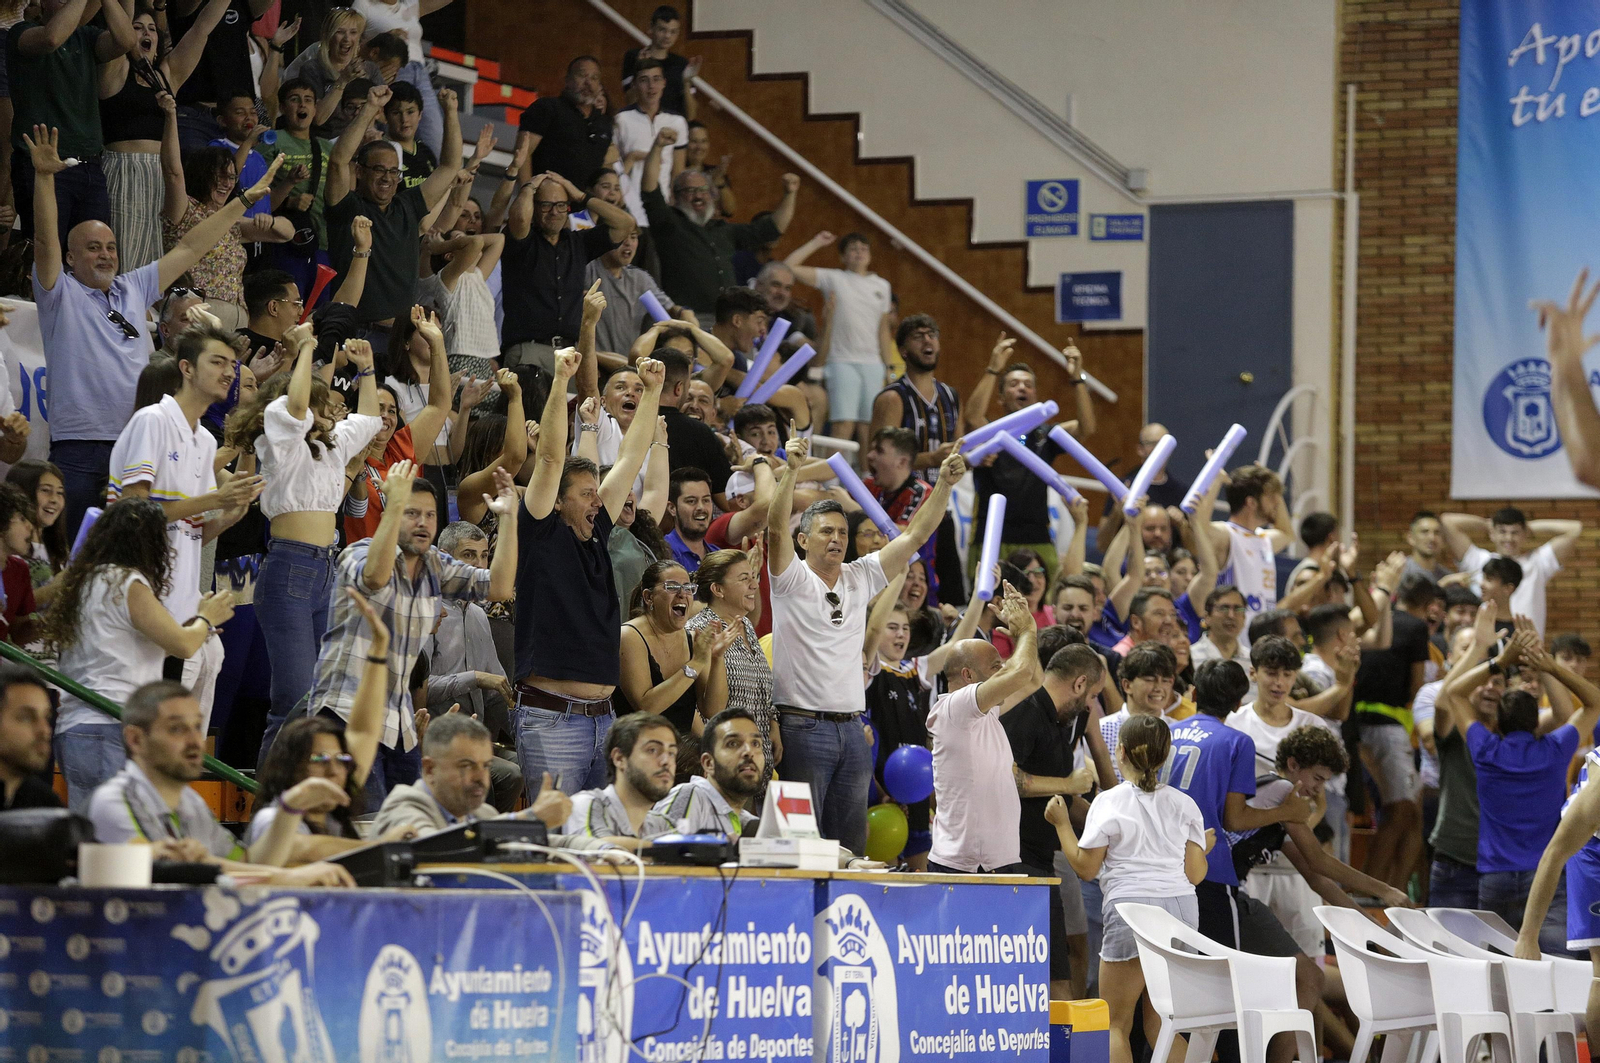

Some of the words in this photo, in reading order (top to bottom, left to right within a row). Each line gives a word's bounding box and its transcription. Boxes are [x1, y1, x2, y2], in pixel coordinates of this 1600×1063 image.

[1509, 85, 1567, 127] tu
[637, 921, 811, 975] Ayuntamiento
[897, 924, 1048, 975] Ayuntamiento
[688, 976, 720, 1020] de
[727, 975, 812, 1018] Huelva
[945, 975, 970, 1014] de
[975, 974, 1049, 1013] Huelva
[727, 1034, 746, 1059] de
[749, 1033, 814, 1063] Deportes
[910, 1029, 976, 1059] Concejalía
[979, 1029, 996, 1052] de
[998, 1027, 1050, 1056] Deportes
